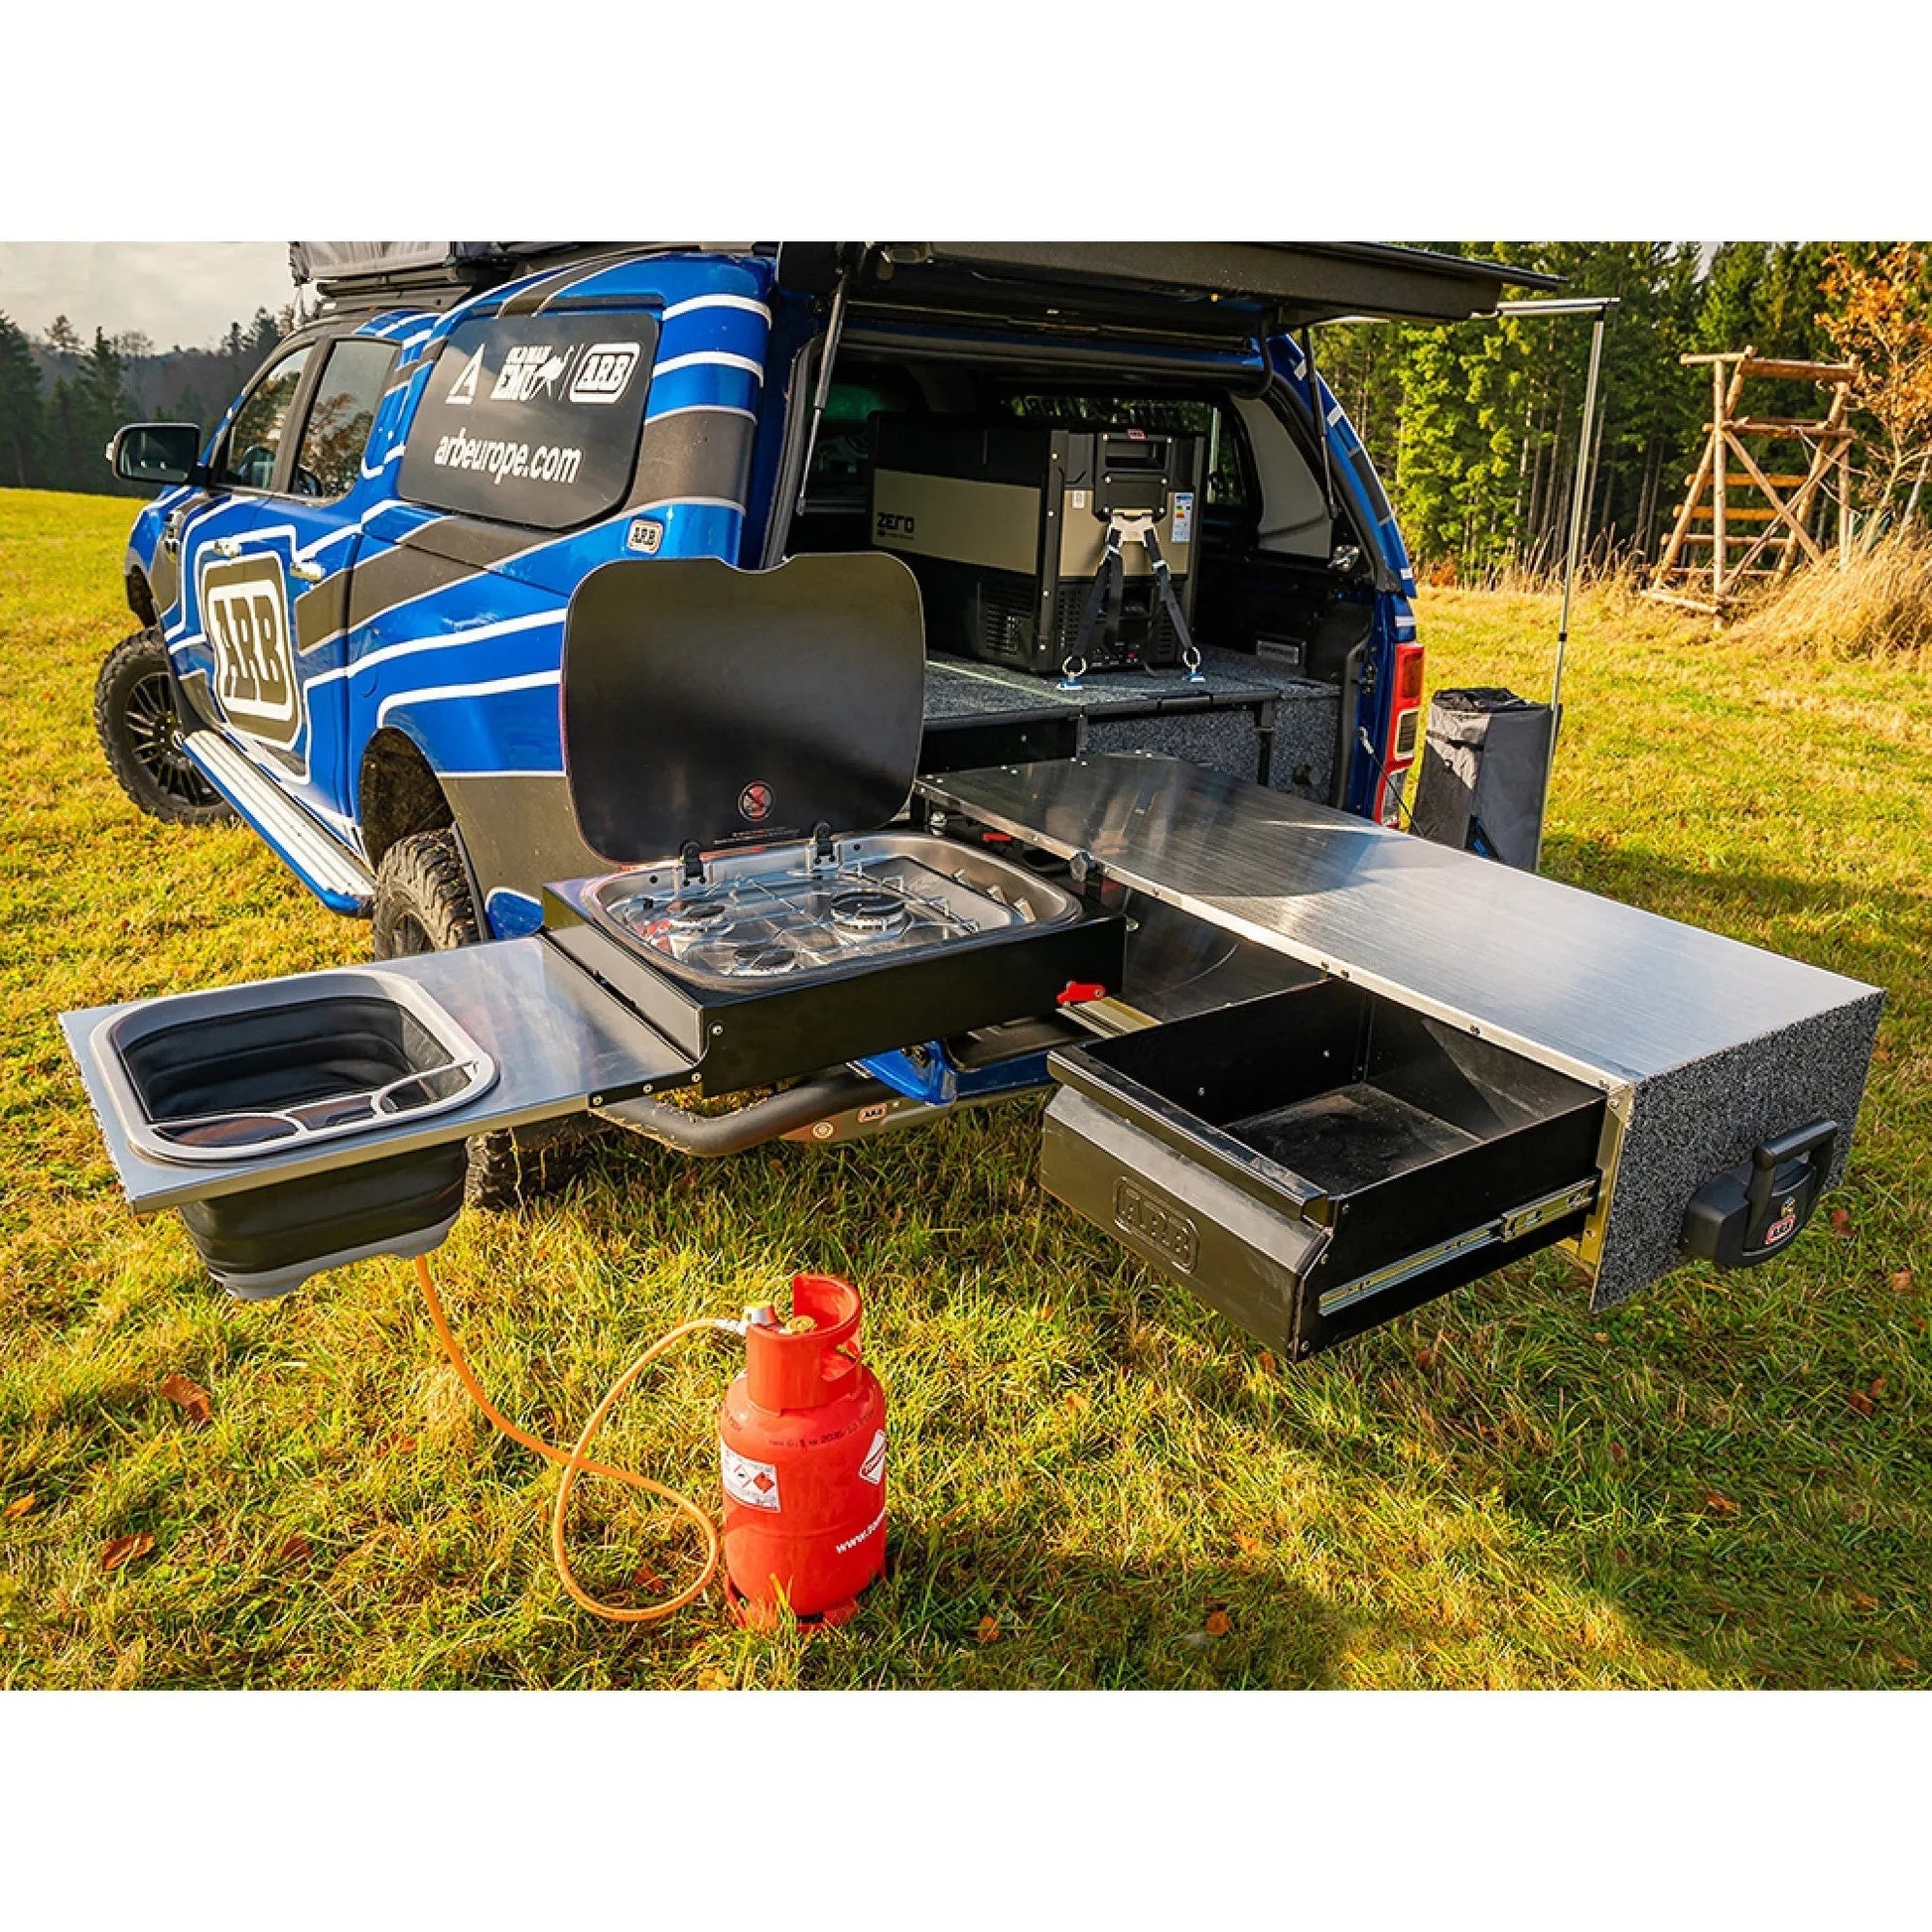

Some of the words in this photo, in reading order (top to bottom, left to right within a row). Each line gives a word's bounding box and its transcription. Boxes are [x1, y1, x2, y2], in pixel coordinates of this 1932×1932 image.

[574, 352, 633, 392] ARB
[434, 427, 583, 484] arbeurope.com
[631, 526, 656, 545] ARB
[212, 596, 289, 706] ARB
[1117, 1189, 1190, 1259] ARB
